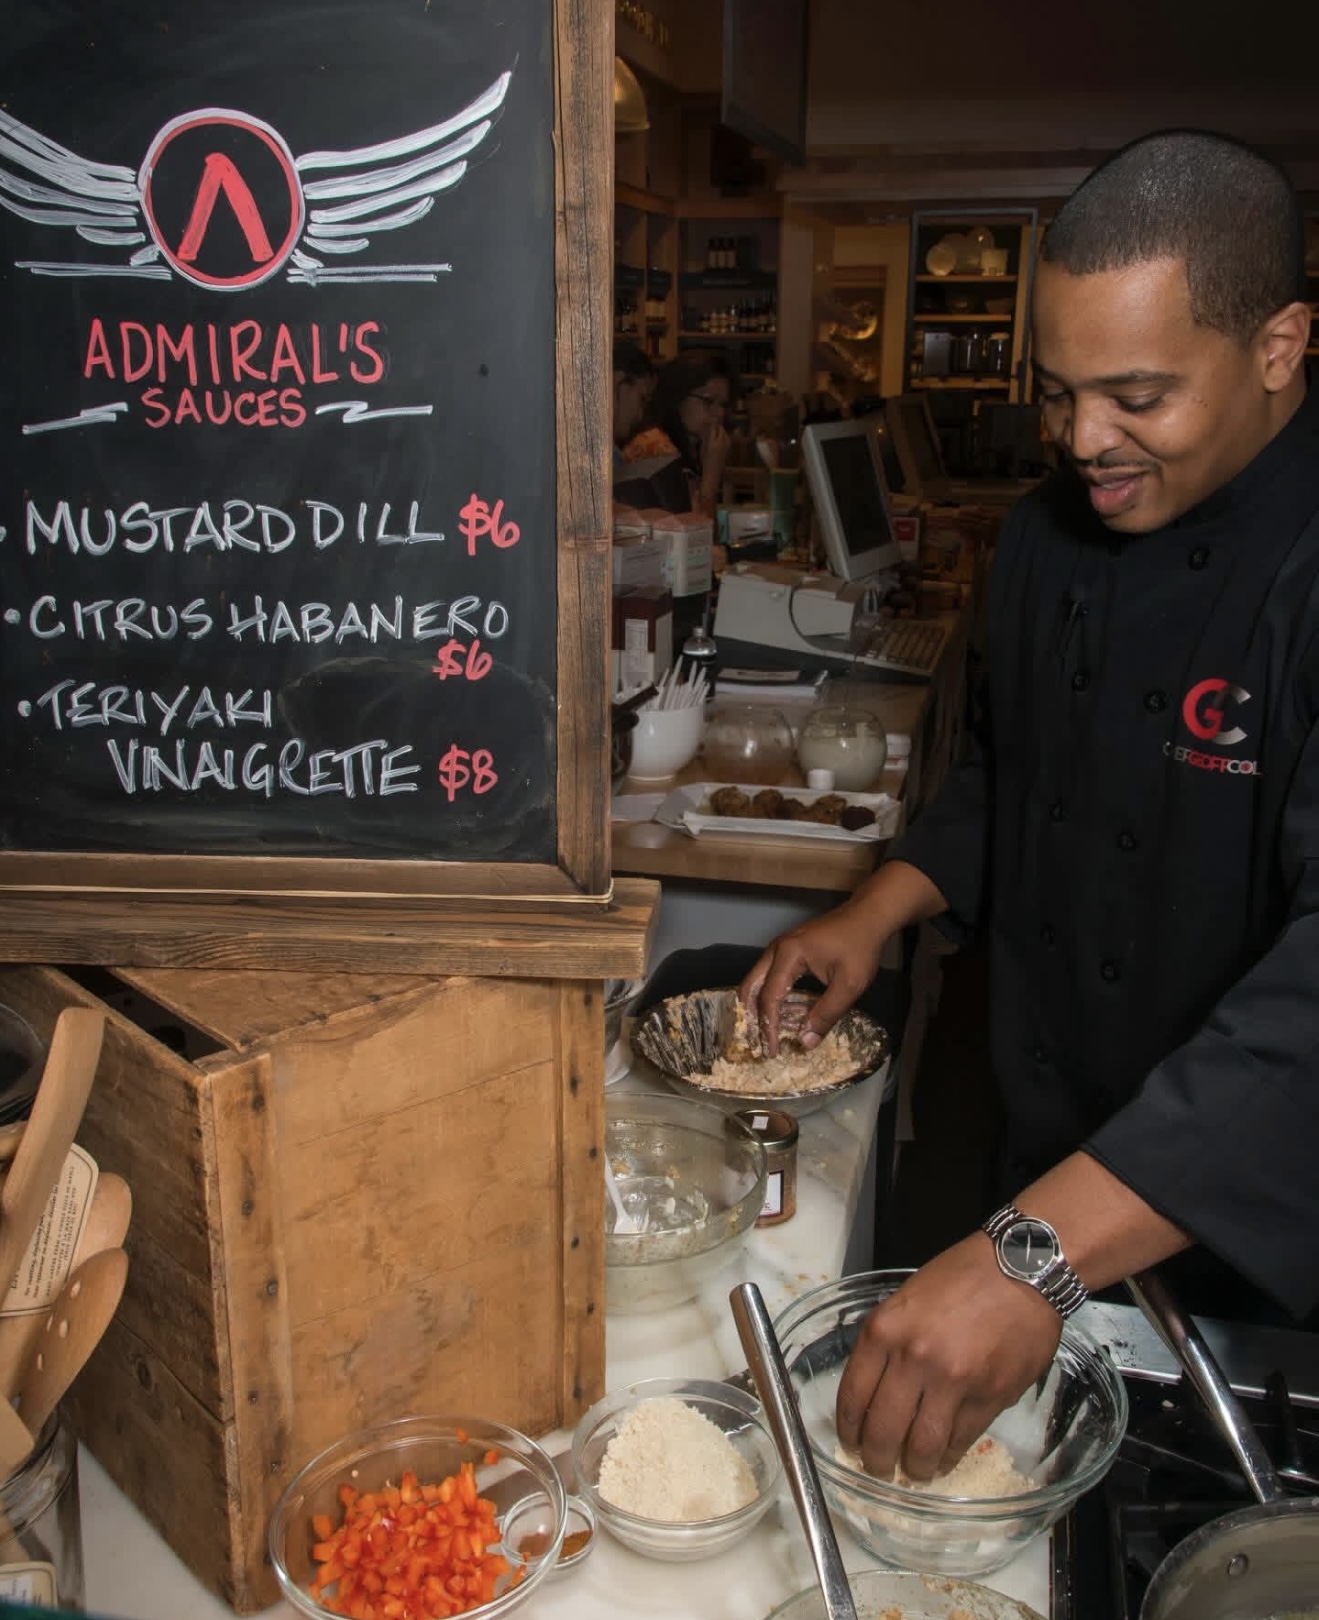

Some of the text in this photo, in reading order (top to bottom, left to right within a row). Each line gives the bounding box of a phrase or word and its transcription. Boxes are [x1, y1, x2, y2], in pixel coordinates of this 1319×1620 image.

[84, 318, 385, 385] ADMIRAL'S
[141, 387, 306, 427] SAUCES
[26, 493, 520, 556] MUSTARD DILL $6
[29, 594, 509, 643] CITRUS HABANERO
[433, 639, 492, 681] $6
[36, 680, 272, 736] TERIYAKI
[106, 737, 498, 801] VINAIGRETTE $8
